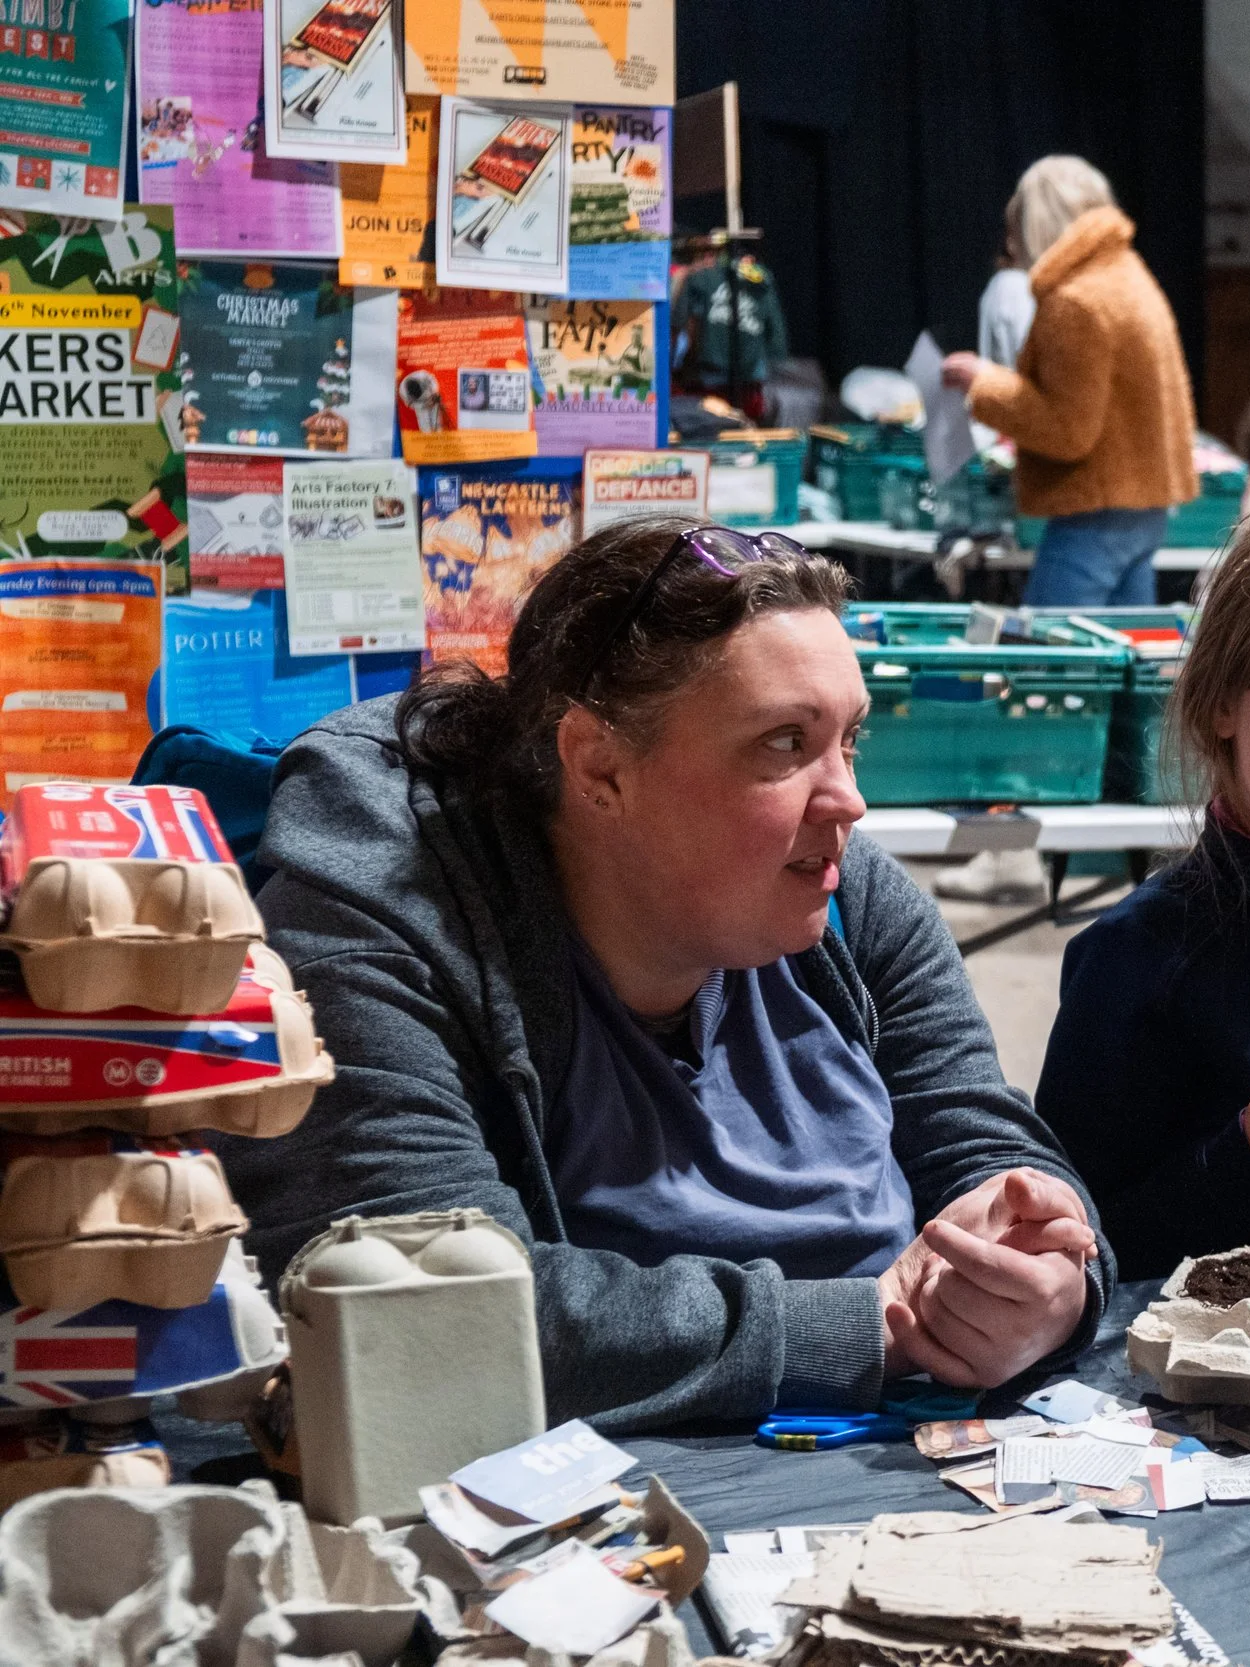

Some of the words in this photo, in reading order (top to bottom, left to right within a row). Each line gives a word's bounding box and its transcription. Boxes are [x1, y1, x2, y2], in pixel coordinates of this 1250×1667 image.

[581, 111, 665, 142] PANTRY
[346, 215, 390, 233] JOIN
[396, 219, 422, 234] US
[95, 269, 173, 287] ARTS
[32, 303, 133, 320] November
[217, 293, 300, 315] CHRISTMAS
[227, 308, 288, 328] MARKET
[0, 380, 152, 418] ARKET
[291, 482, 322, 495] Arts
[325, 480, 380, 495] Factory
[461, 481, 560, 500] NEWCASTLE
[595, 478, 694, 499] DEFIANCE
[291, 497, 369, 511] Illustration
[480, 498, 572, 516] LANTERNS
[37, 575, 86, 593] Evening
[520, 1431, 604, 1476] the
